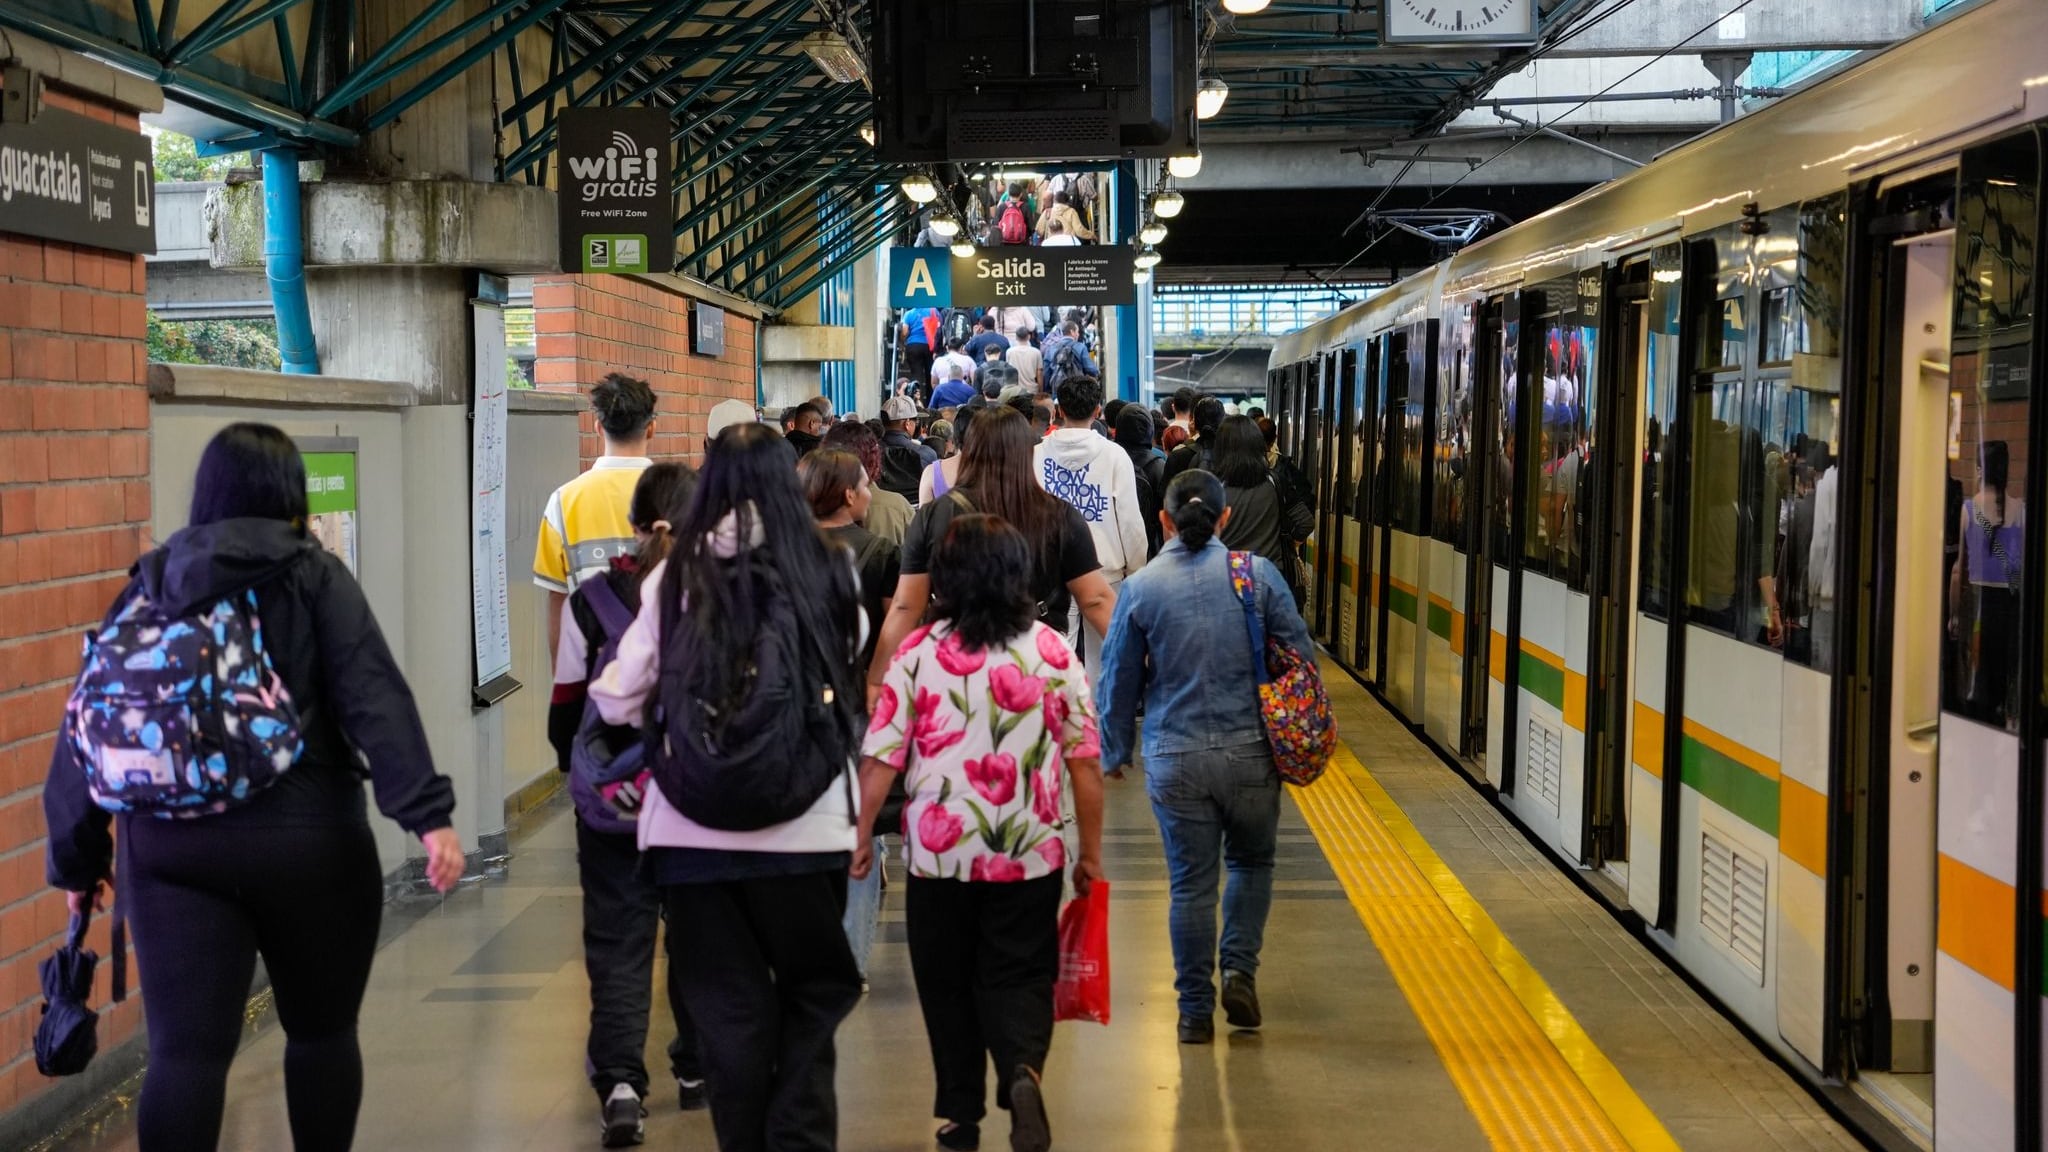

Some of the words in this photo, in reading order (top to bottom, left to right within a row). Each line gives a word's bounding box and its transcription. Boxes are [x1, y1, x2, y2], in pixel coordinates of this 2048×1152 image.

[0, 146, 82, 204] guacatala
[582, 177, 657, 202] gratis
[581, 209, 601, 217] Free
[603, 209, 623, 217] WiFi
[625, 209, 648, 217] Zone
[904, 257, 937, 297] A
[976, 257, 1046, 279] Salida
[995, 281, 1027, 296] Exit
[1045, 484, 1100, 497] MOTION
